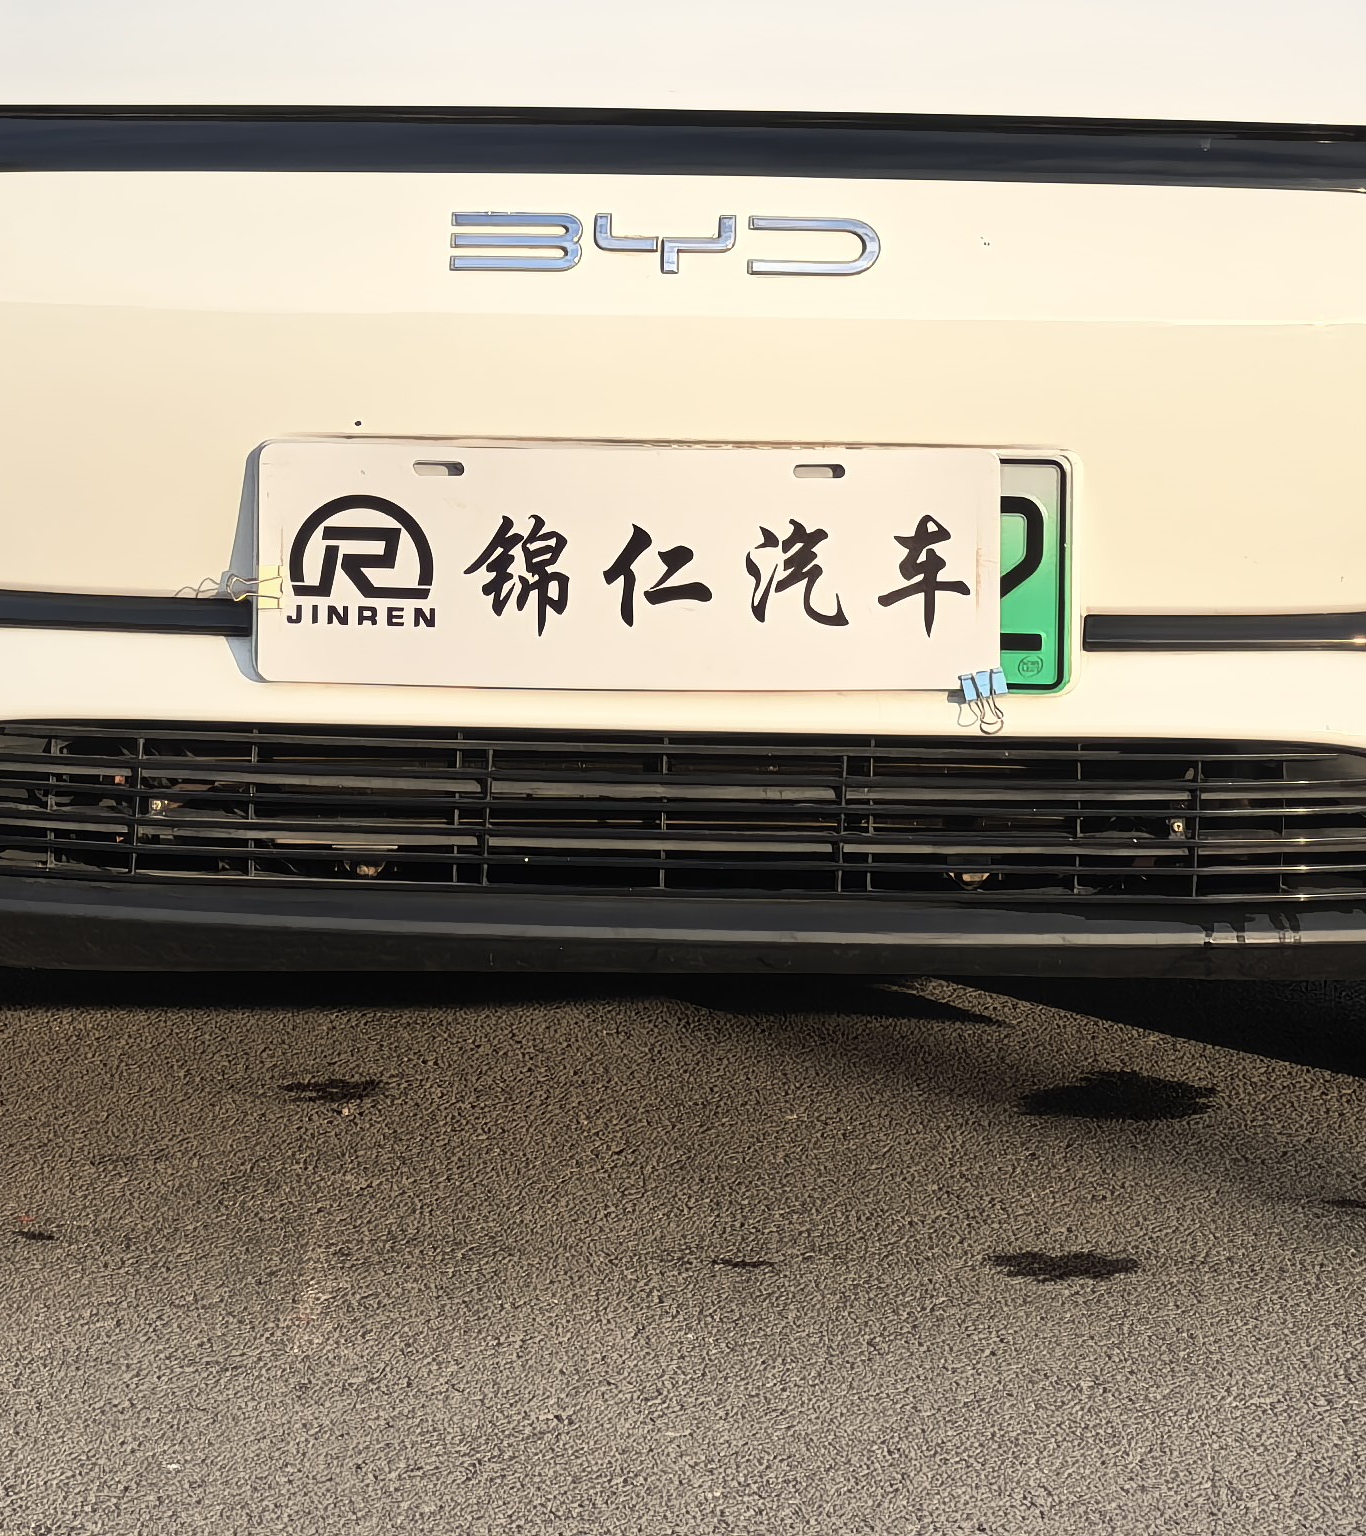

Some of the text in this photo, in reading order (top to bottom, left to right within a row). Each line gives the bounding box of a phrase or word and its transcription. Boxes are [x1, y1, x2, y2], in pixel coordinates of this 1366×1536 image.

[449, 211, 882, 277] BYD
[463, 513, 972, 638] 锦仁汽车
[286, 604, 436, 628] JINREN
